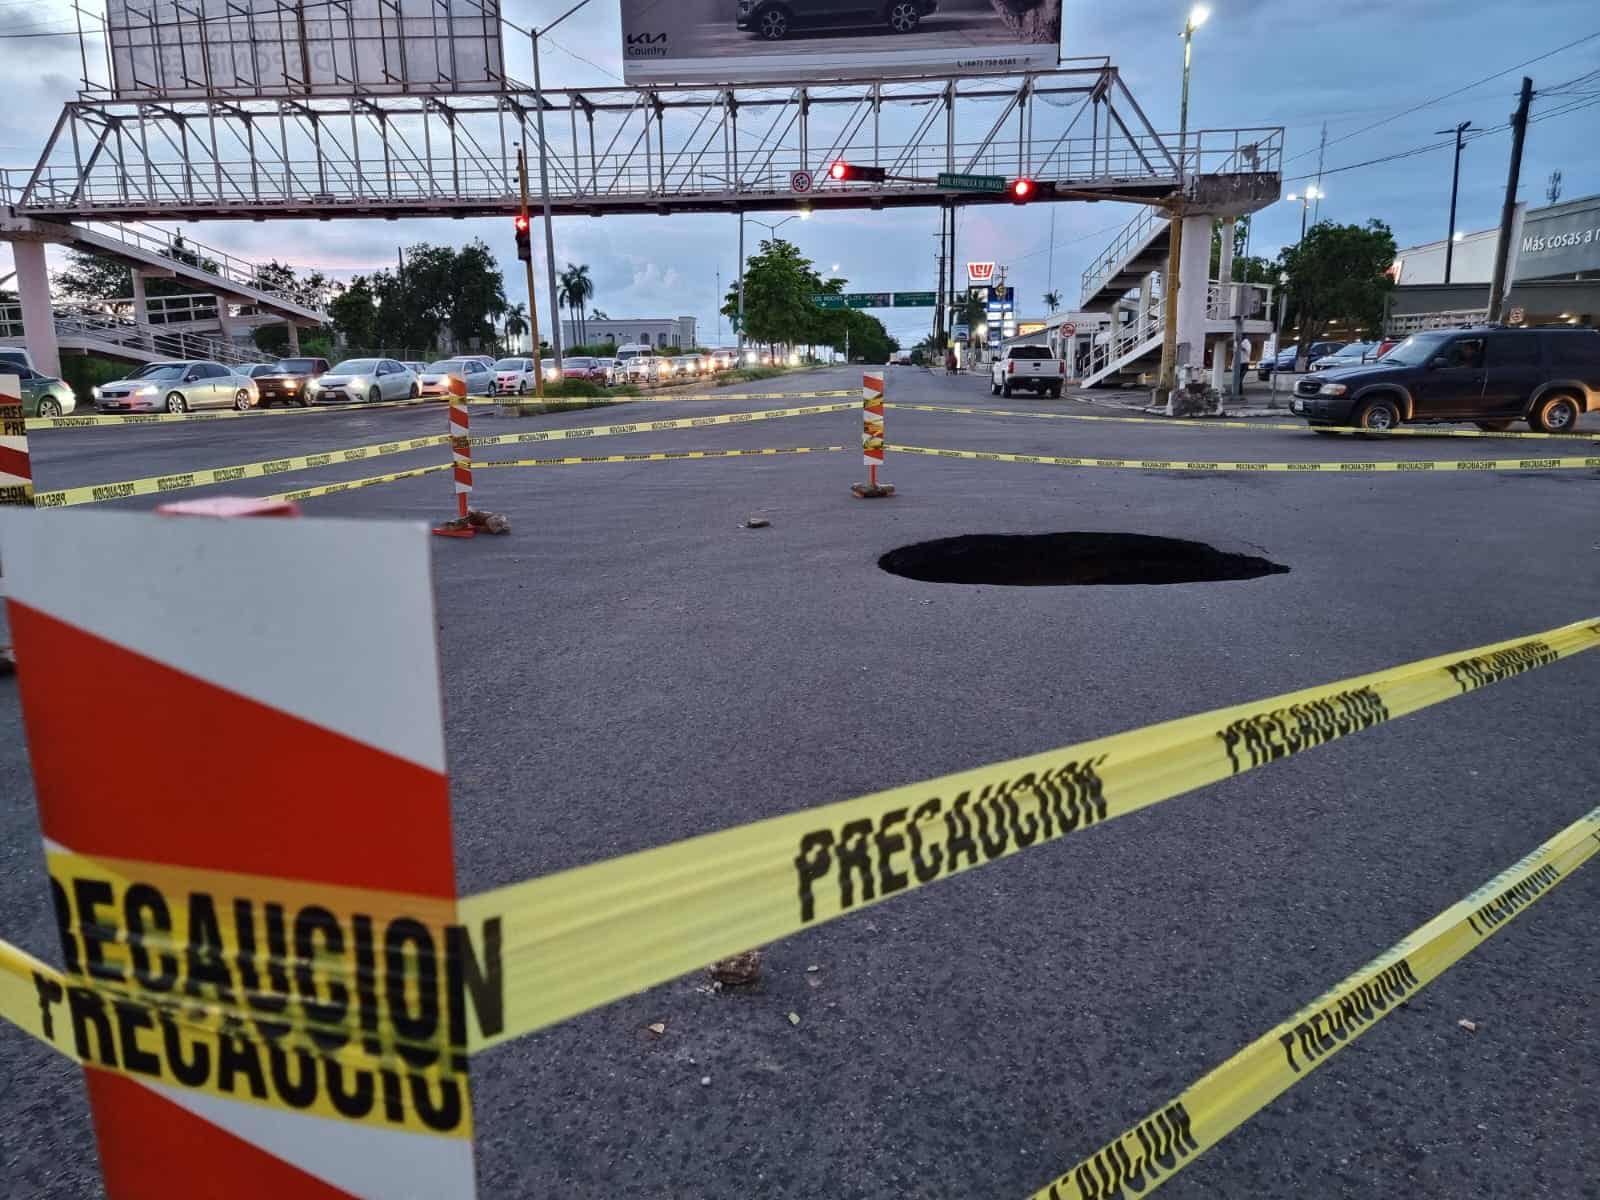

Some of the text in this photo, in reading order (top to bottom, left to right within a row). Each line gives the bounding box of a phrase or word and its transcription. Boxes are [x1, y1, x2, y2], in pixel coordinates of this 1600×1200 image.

[628, 46, 668, 57] Country
[1547, 232, 1581, 249] cosas
[1584, 230, 1592, 243] a
[795, 755, 1109, 923] PRECAUCION
[1216, 685, 1390, 773] PRECAUCION
[1279, 959, 1419, 1073] PRECAUCION
